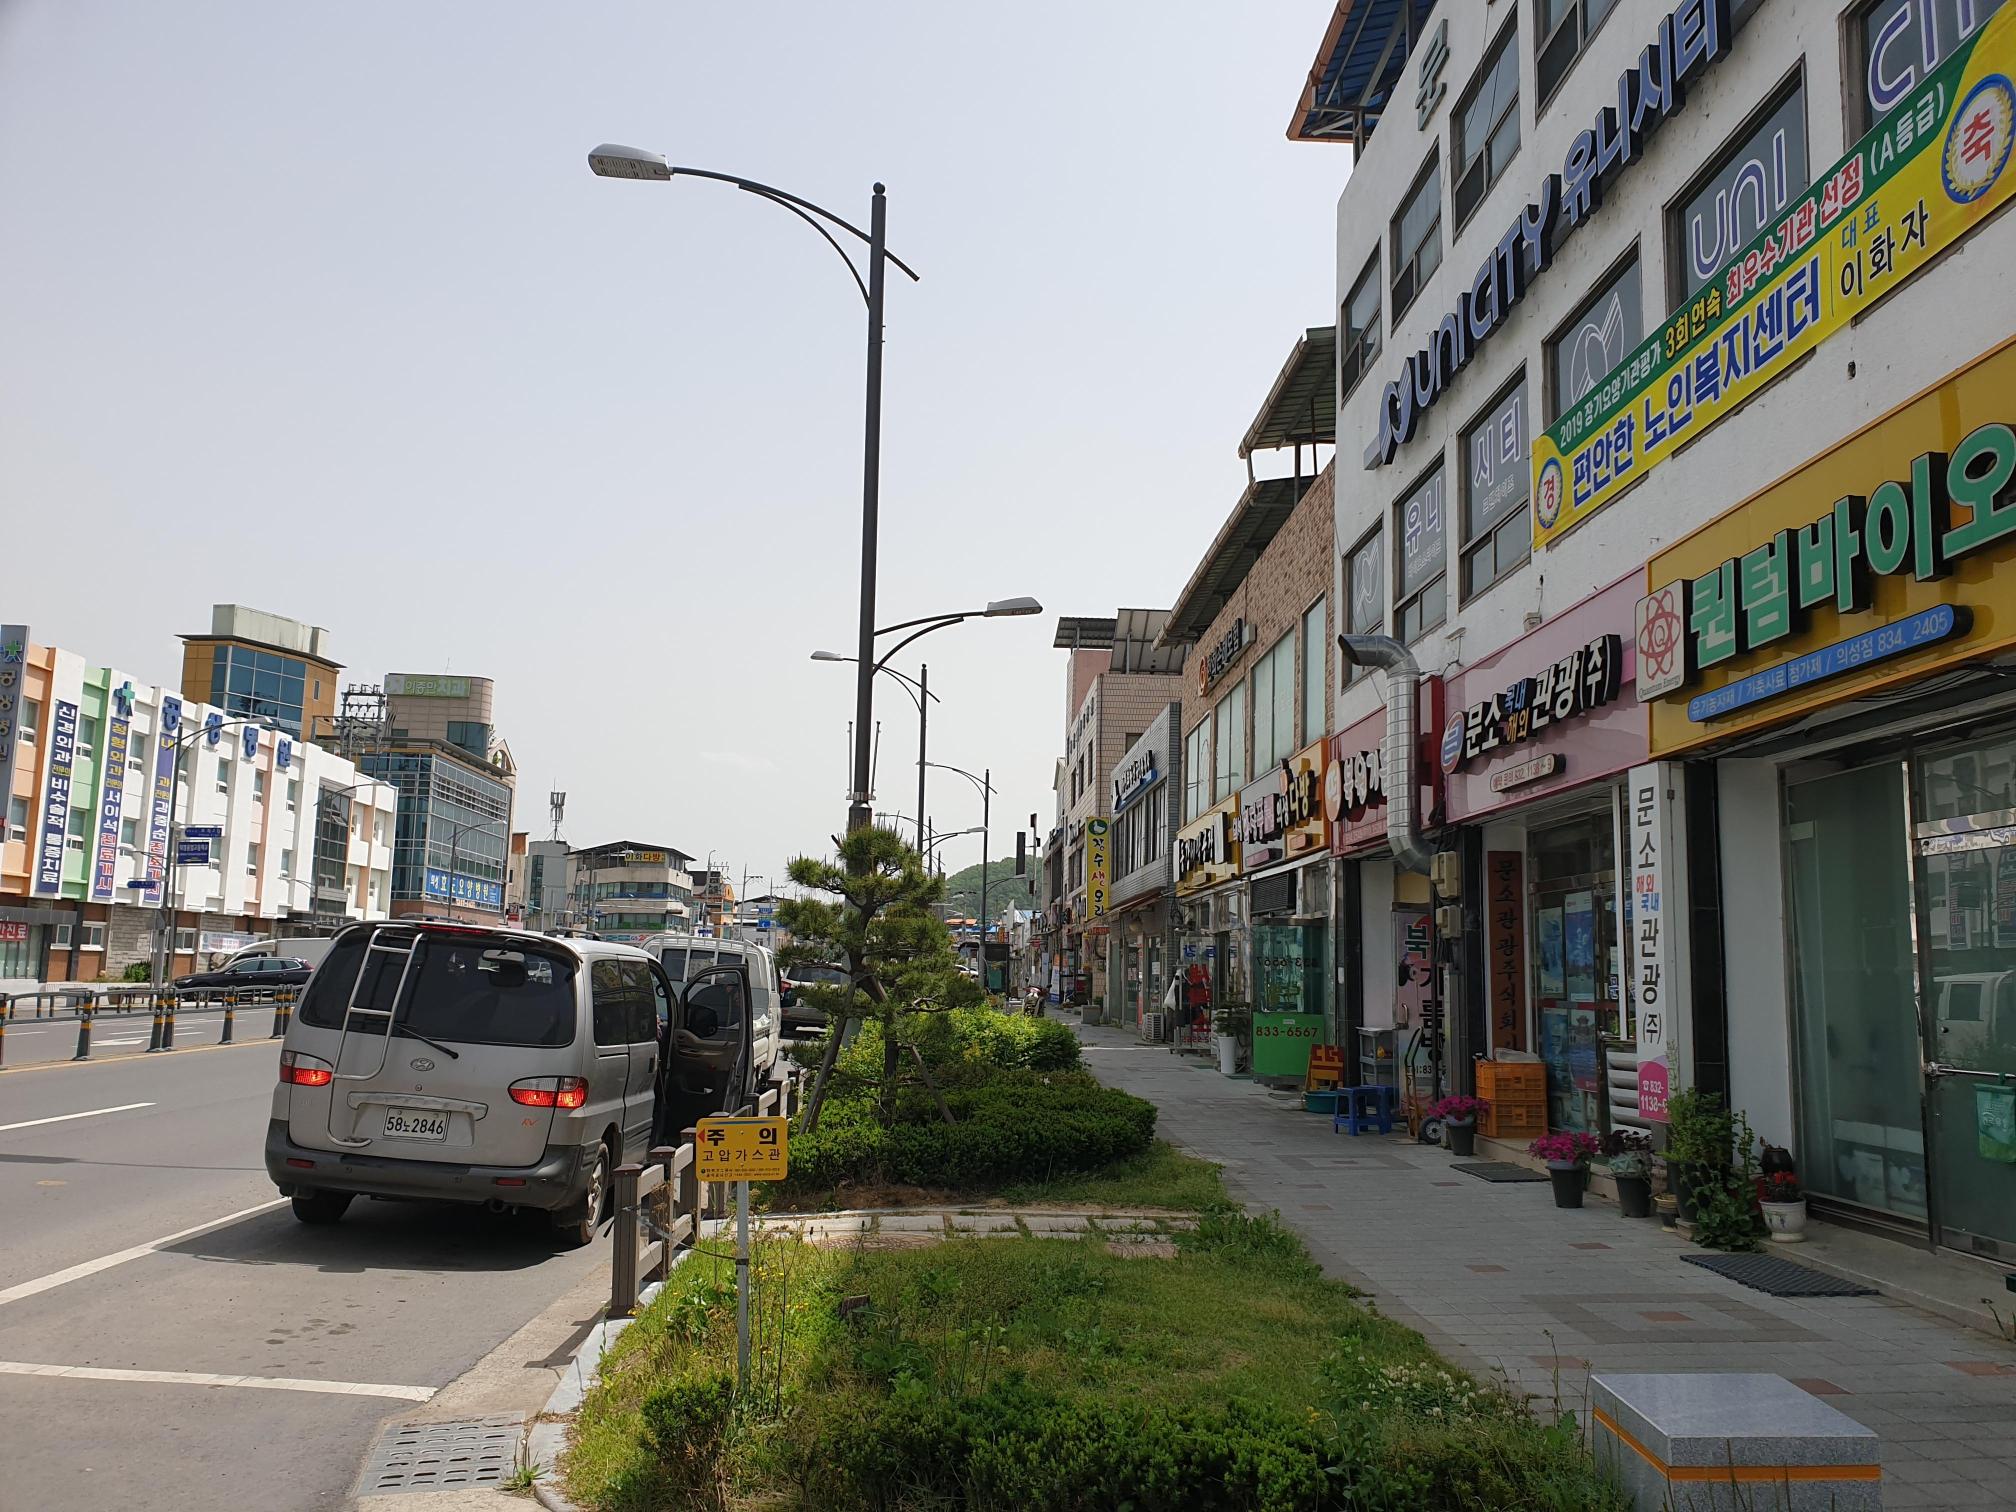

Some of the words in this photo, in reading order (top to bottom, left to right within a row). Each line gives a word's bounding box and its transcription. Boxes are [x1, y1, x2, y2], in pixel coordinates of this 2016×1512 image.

[1561, 0, 1718, 226] 유니시티
[1959, 107, 1995, 165] 축
[1559, 411, 1584, 448] 2019
[1584, 339, 1661, 428] 장기요양기관평가
[1819, 153, 1865, 229] 선정
[1870, 82, 1944, 175] (A등급)
[1841, 199, 1928, 297] 이화자
[1572, 412, 1635, 511] 편안한
[1643, 254, 1821, 453] 노인복지센터
[1474, 396, 1520, 488] 시티
[1405, 475, 1441, 557] 유니
[1543, 475, 1556, 510] 경
[1837, 643, 1873, 666] 의성점
[1913, 611, 1949, 641] 2405
[54, 704, 76, 763] 신경외과
[1465, 693, 1502, 759] 문소
[1504, 679, 1527, 714] 국내
[1506, 707, 1530, 745] 해외
[47, 776, 69, 829] 비수술적
[1636, 786, 1656, 869] 문소
[40, 833, 63, 884] 통증치료
[625, 852, 661, 862] 이화다방
[1091, 838, 1105, 917] 장수생오리
[1405, 924, 1431, 960] 북
[1255, 1026, 1318, 1038] 833-6567
[386, 1116, 444, 1135] 58노2846
[706, 1127, 777, 1147] 주의
[701, 1148, 781, 1162] 고압가스관
